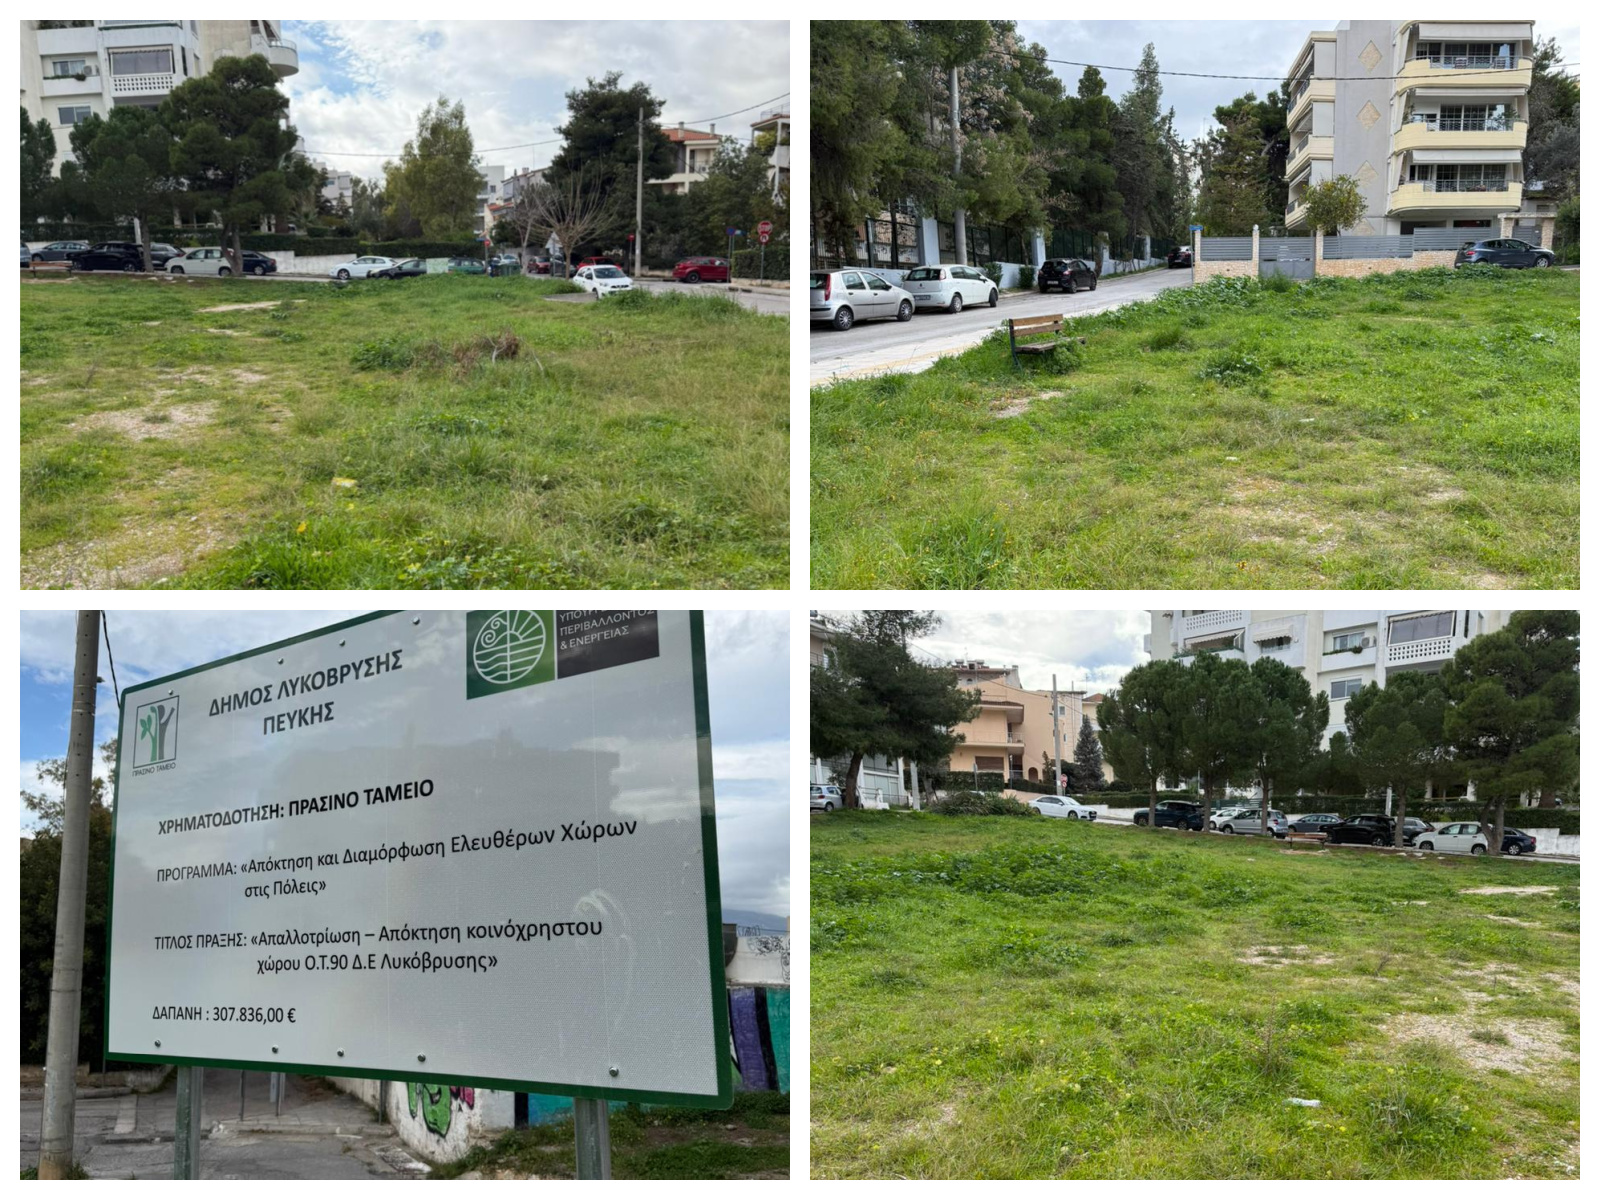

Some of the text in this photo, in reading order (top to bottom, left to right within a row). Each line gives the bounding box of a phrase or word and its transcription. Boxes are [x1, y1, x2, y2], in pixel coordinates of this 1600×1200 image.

[560, 625, 630, 650] & ΕΝΕΡΓΕΙΑΣ
[209, 649, 403, 717] ΔΗΜΟΣ ΛΥΚΟΒΡΥΣΗΣ
[263, 701, 335, 736] ΠΕΥΚΗΣ
[158, 779, 435, 835] ΧΡΗΜΑΤΟΔΟΤΗΣΗ: ΠΡΑΣΙΝΟ ΤΑΜΕΙΟ
[156, 819, 638, 883] ΠΡΟΓΡΑΜΜΑ: «Απόκτηση και Διαμόρφωση Ελευθέρων Χώρων
[244, 879, 327, 900] στις Πόλεις»
[154, 935, 193, 950] ΤΙΤΛΟΣ
[196, 932, 247, 949] ΠΡΑΞΗΣ:
[250, 927, 361, 948] «Απαλλοτρίωση
[378, 925, 461, 943] Απόκτηση
[466, 919, 603, 942] κοινόχρηστου
[257, 952, 498, 975] χώρου Ο.Τ.90 Δ.Ε Λυκόβρυσης»
[152, 1006, 203, 1021] ΔΑΠΑΝΗ
[212, 1006, 285, 1025] 307.836,00
[286, 1007, 297, 1024] €
